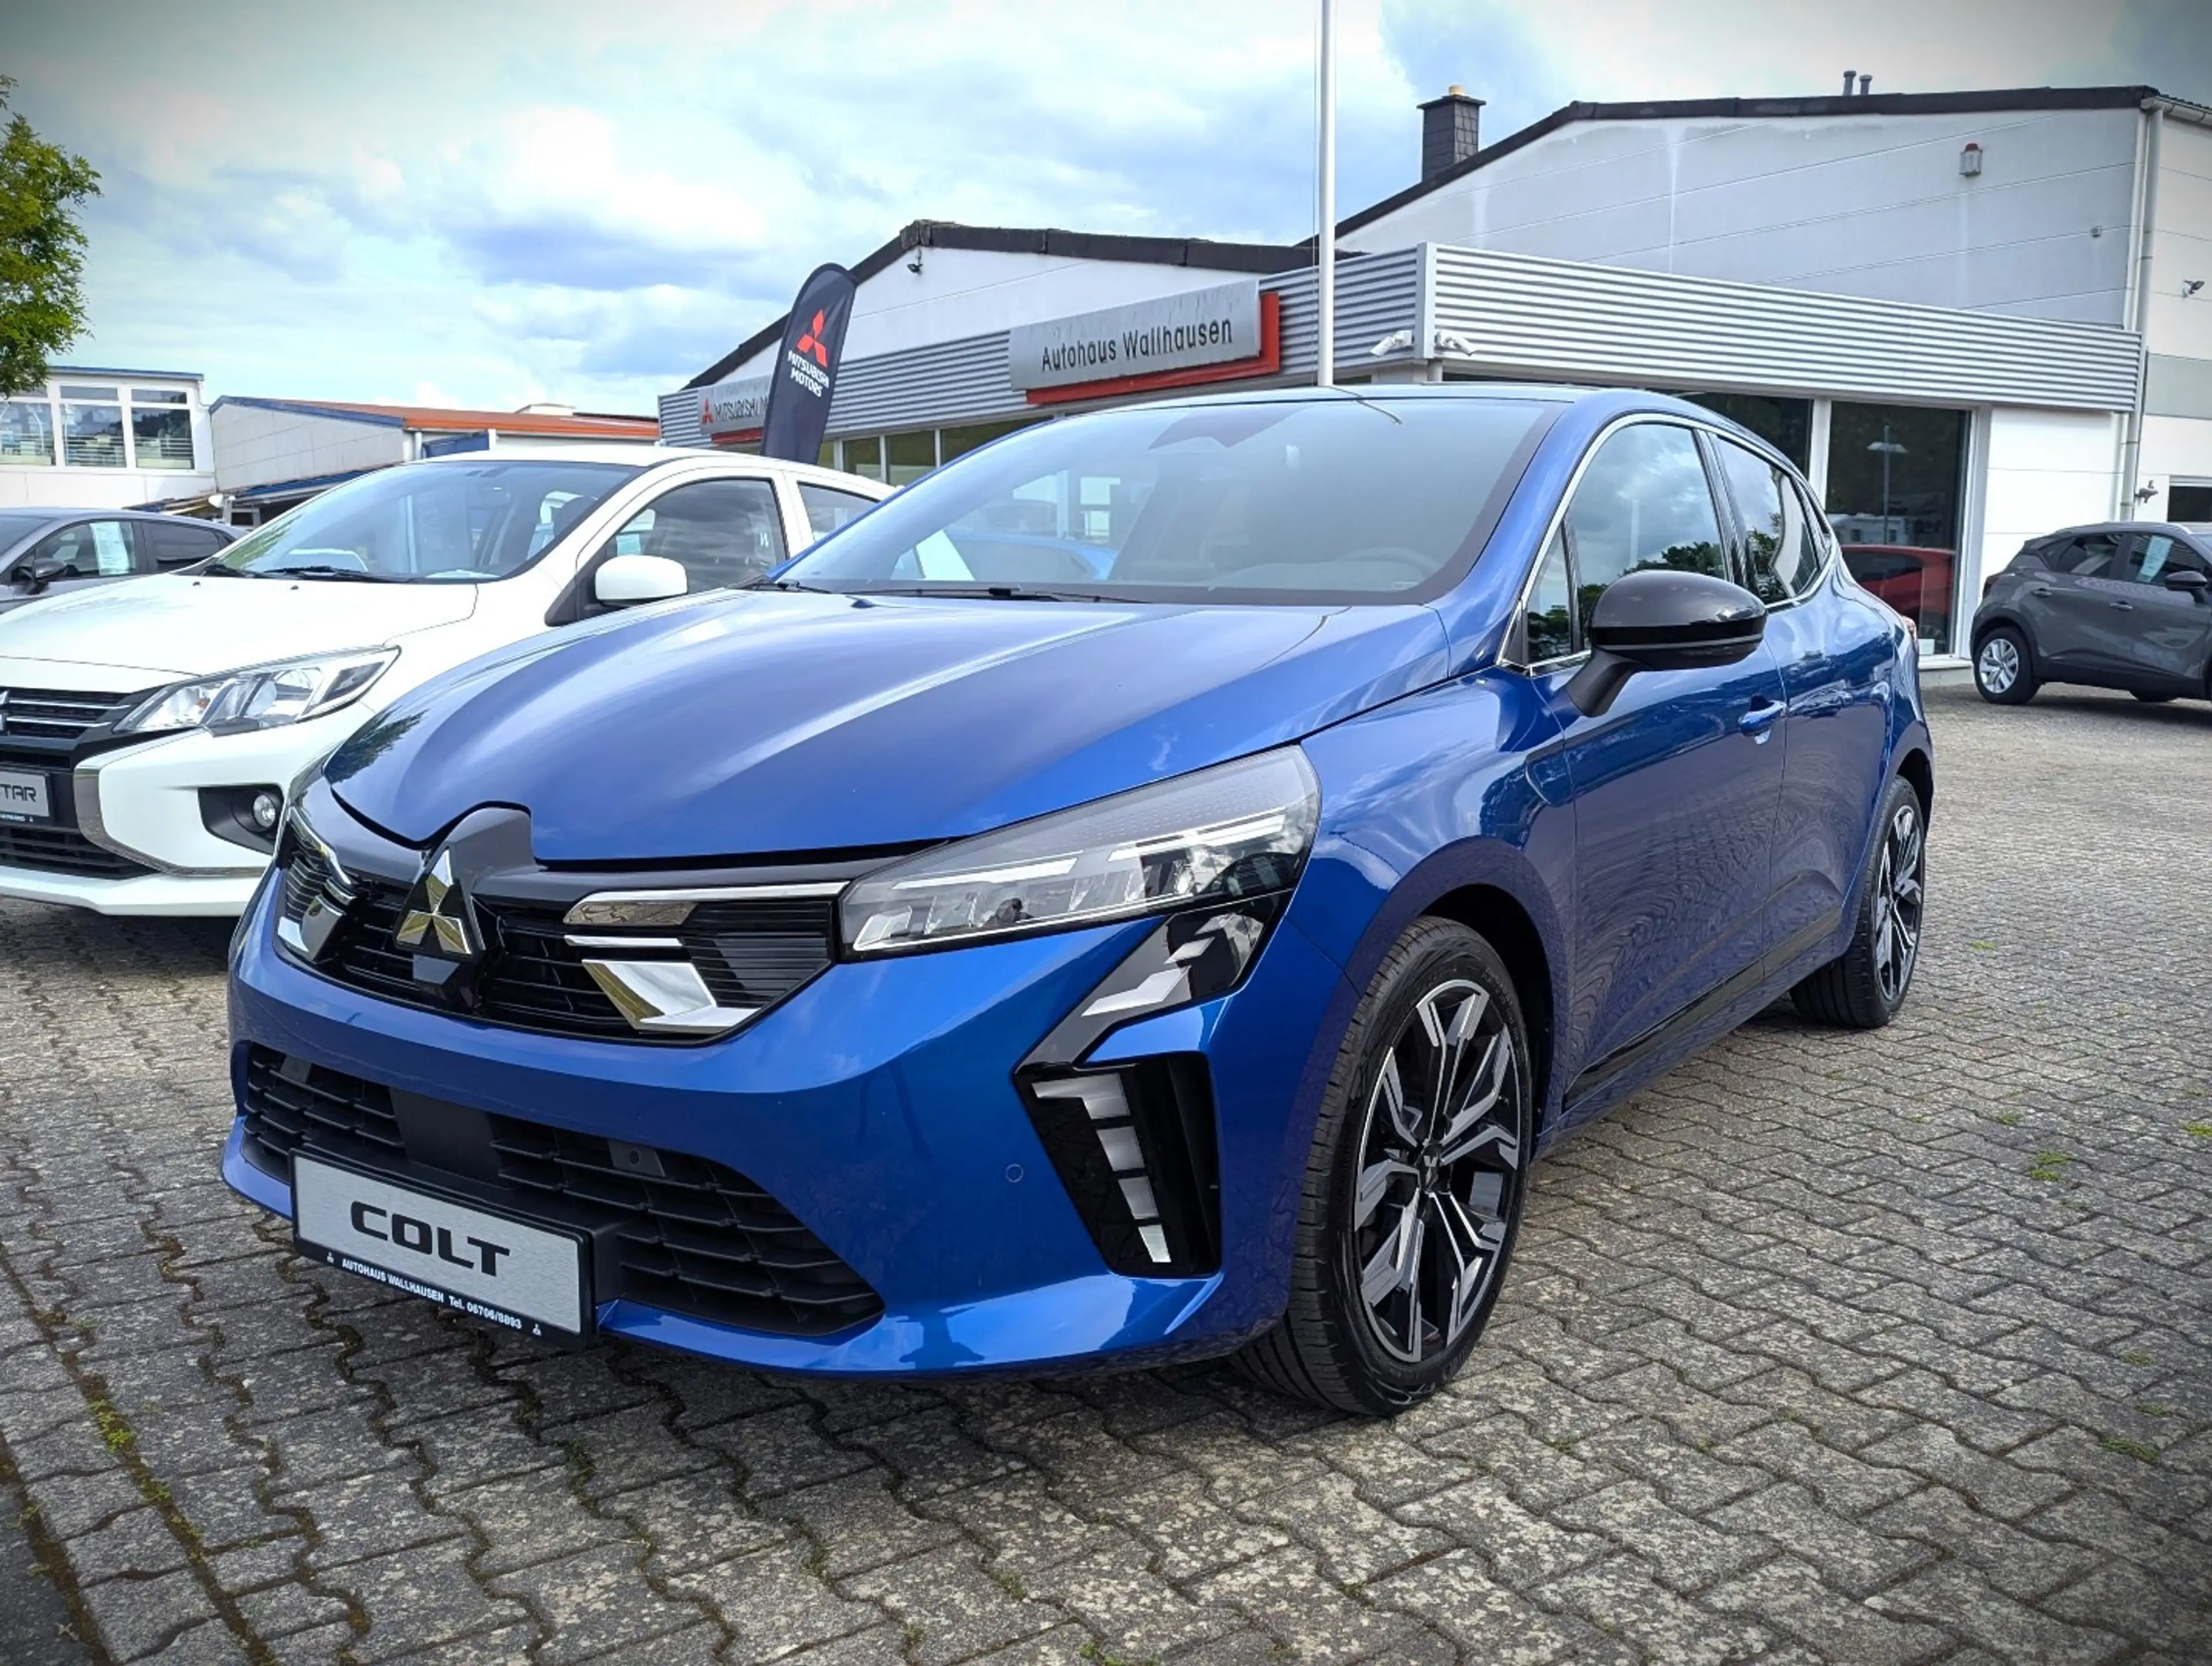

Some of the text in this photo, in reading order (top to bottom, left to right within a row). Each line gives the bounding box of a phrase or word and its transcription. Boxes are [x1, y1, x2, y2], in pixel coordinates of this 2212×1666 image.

[1042, 318, 1233, 372] Autohaus Wallhausen
[787, 350, 830, 389] MITSUBISHI
[790, 367, 823, 397] MOTORS
[0, 783, 36, 803] TAR
[350, 1200, 510, 1277] COLT
[342, 1258, 386, 1282] AUTOHAUS
[387, 1273, 444, 1302] WALLHAUSEN
[449, 1295, 465, 1310] Tel.
